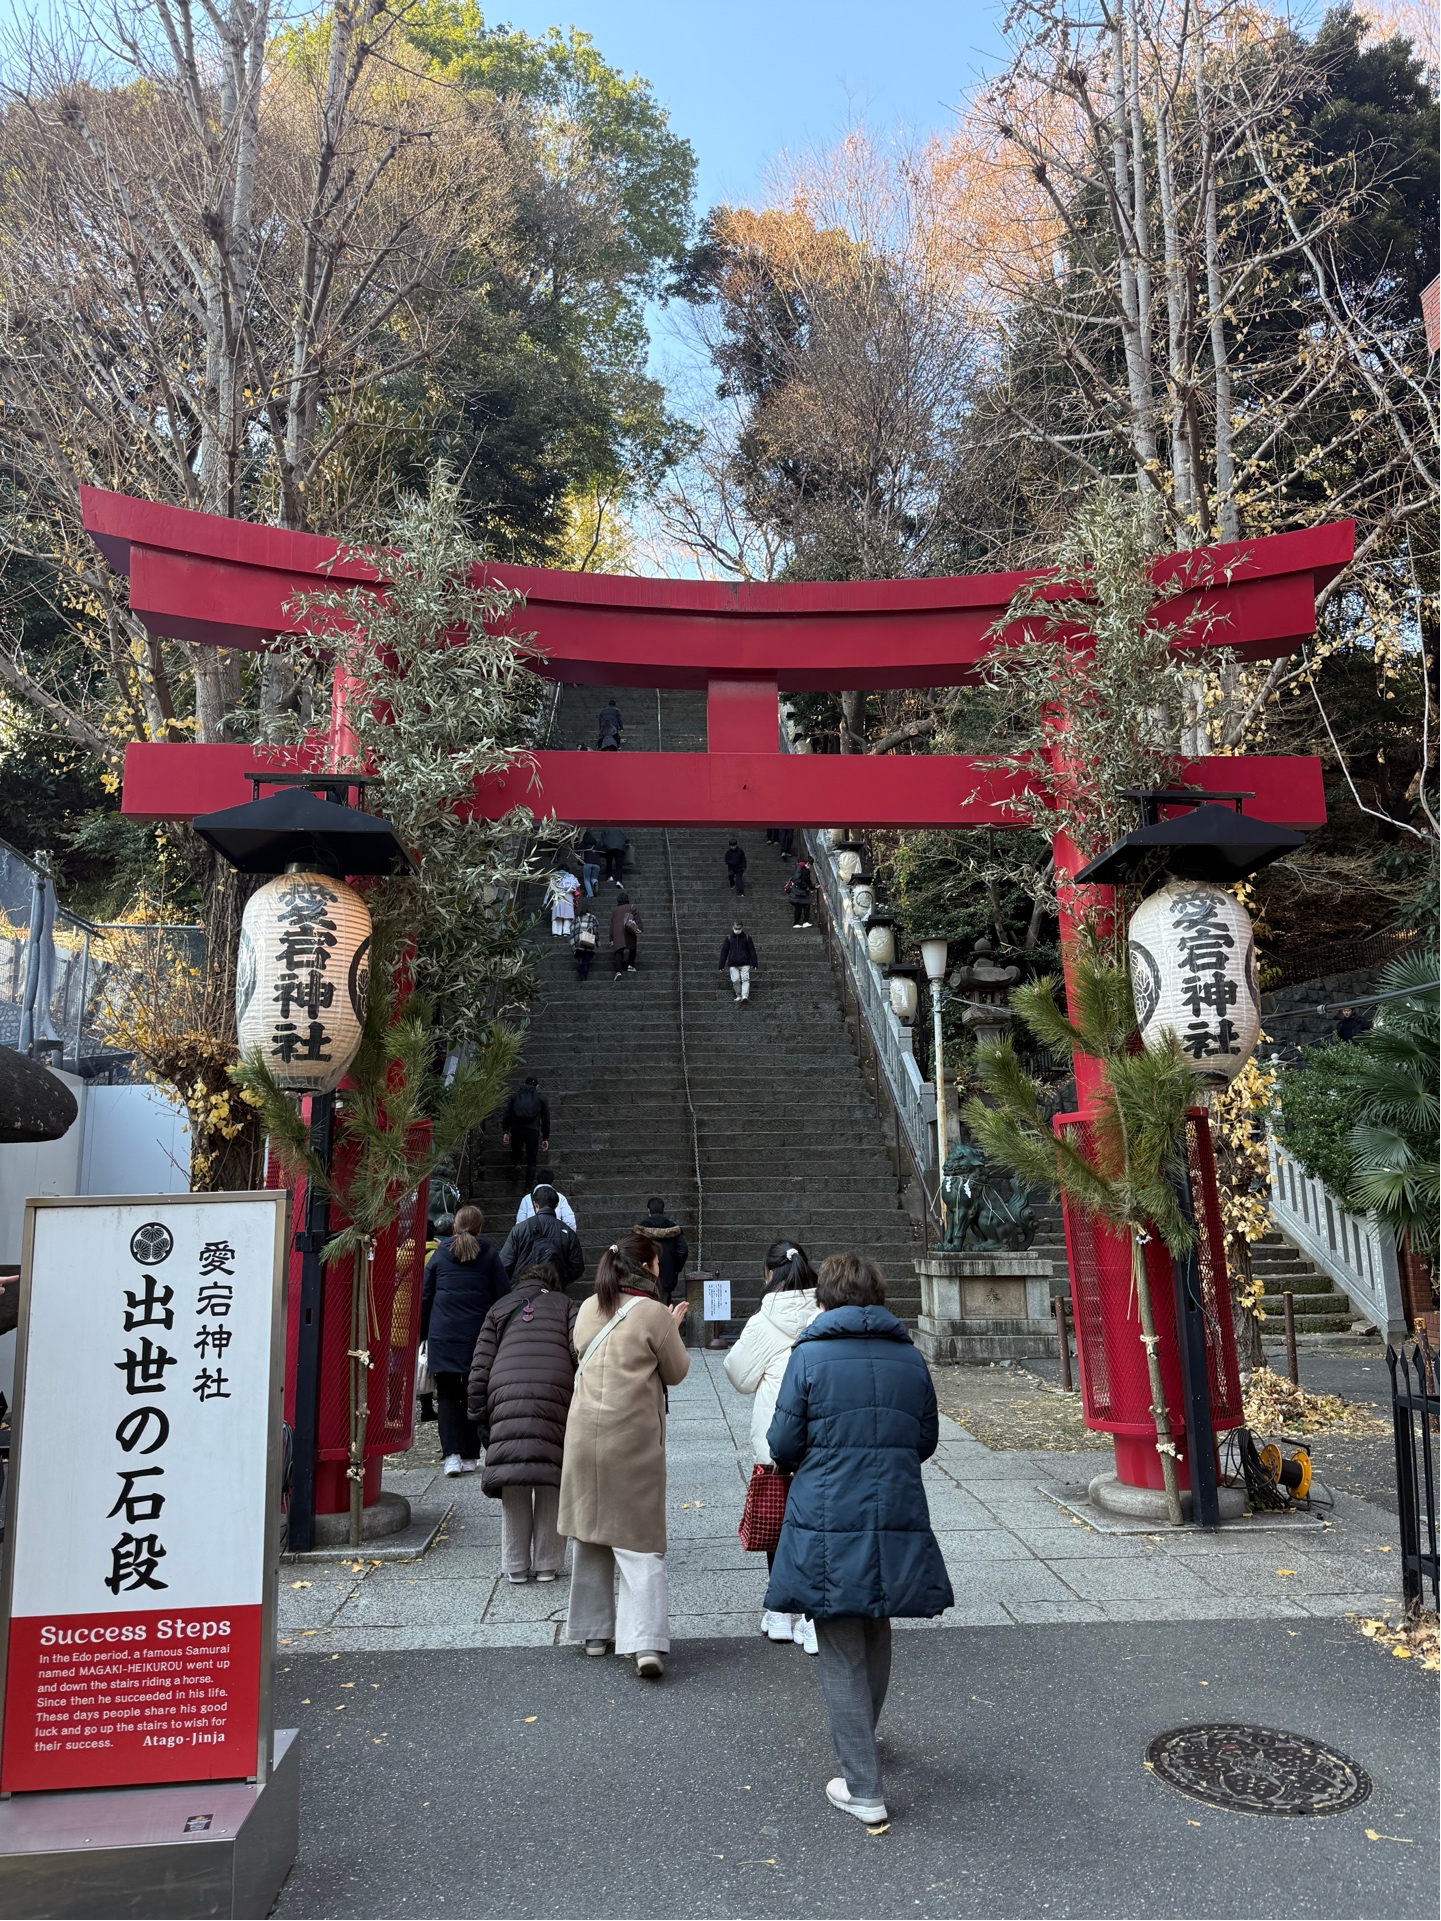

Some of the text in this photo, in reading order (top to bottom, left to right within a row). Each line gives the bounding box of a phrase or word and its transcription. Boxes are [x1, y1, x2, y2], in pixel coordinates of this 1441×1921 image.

[270, 882, 339, 1064] 愛宕神社
[1168, 889, 1242, 1060] 愛宕神社
[192, 1240, 236, 1403] 愛宕神社
[104, 1273, 178, 1596] 出世の石段
[40, 1618, 231, 1646] Success Steps
[39, 1654, 50, 1664] In
[52, 1653, 70, 1663] the
[72, 1652, 92, 1662] Edo
[133, 1651, 141, 1659] a
[142, 1648, 183, 1658] famous
[185, 1643, 230, 1656] Samurai
[38, 1659, 231, 1679] named MAGAKI-HEIKUROU went up
[37, 1675, 214, 1693] and down the stairs riding a horse.
[36, 1687, 229, 1708] Since then he succeeded in his life.
[36, 1701, 228, 1722] These days people share his good
[34, 1716, 227, 1737] luck and go up the stairs to wish for
[34, 1731, 226, 1752] their success. Atago-Jinja
